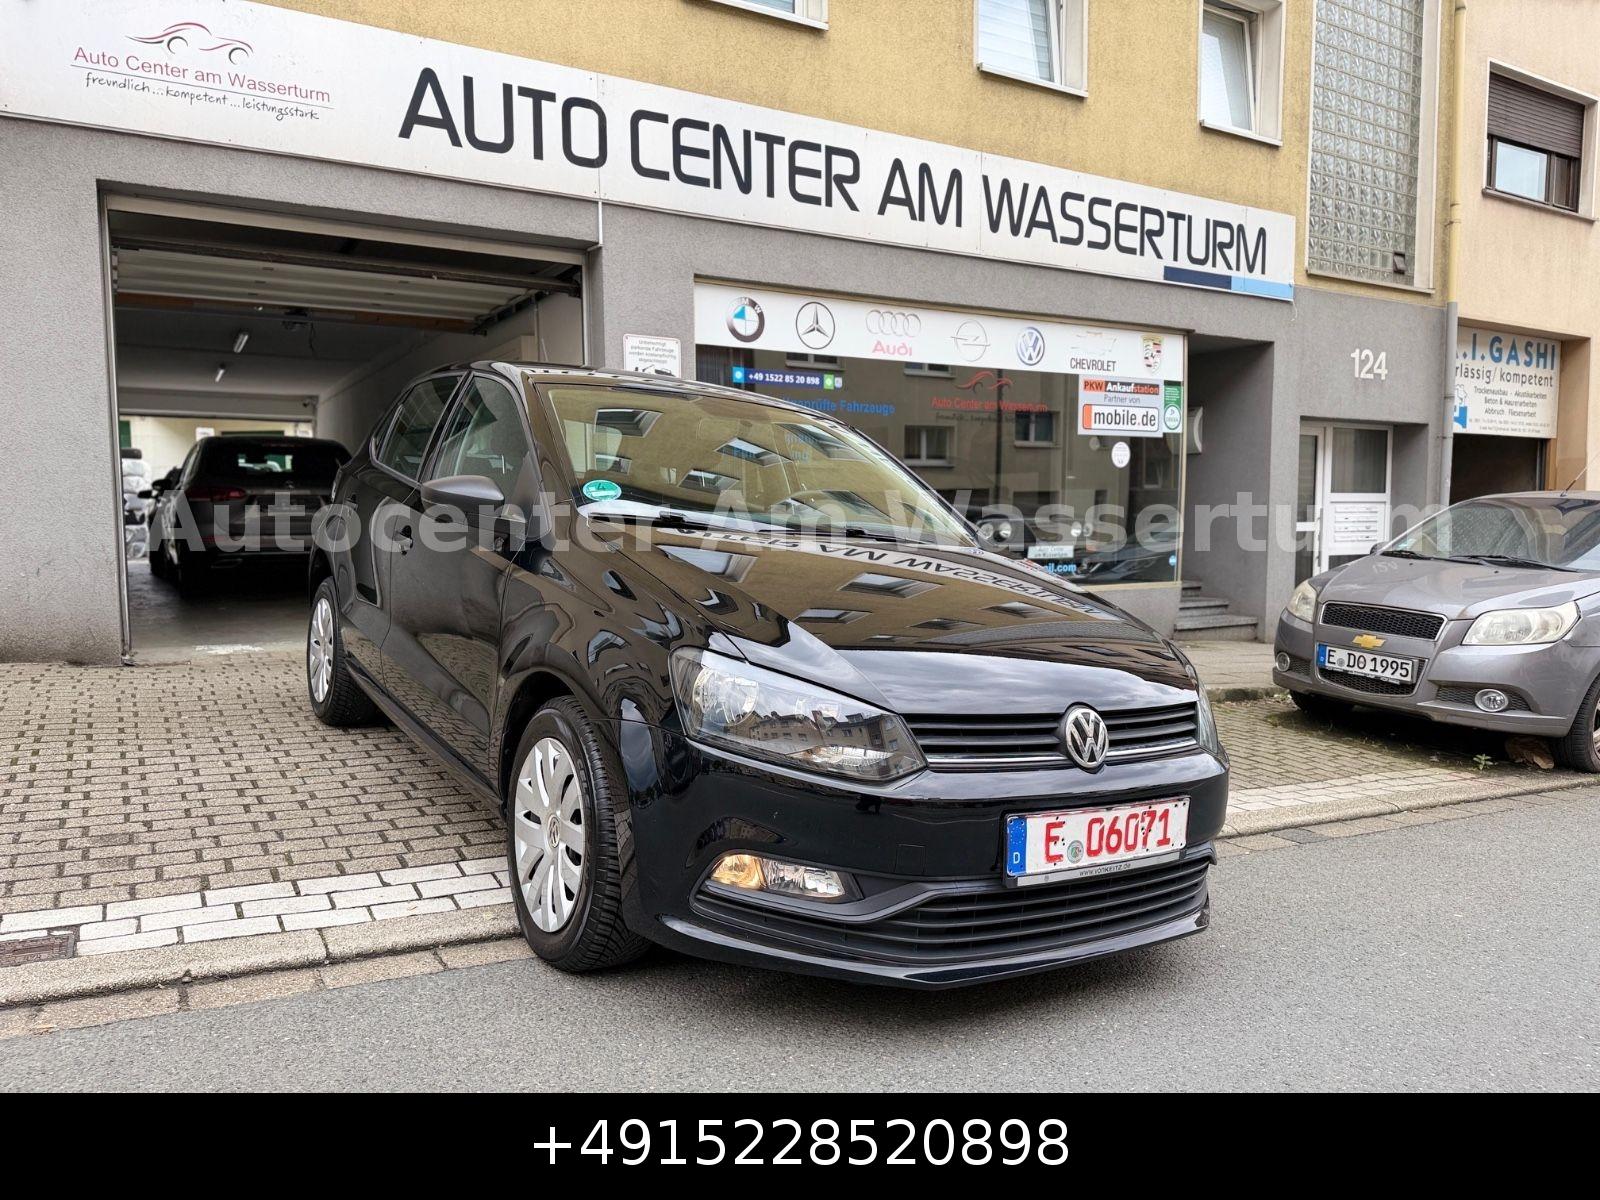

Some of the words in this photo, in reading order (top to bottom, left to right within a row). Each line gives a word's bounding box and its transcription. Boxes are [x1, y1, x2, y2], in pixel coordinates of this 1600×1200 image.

[74, 46, 119, 68] Auto
[126, 55, 189, 80] Center
[194, 66, 222, 85] am
[227, 72, 331, 103] Wasserturm
[398, 66, 608, 170] AUTO
[629, 108, 860, 212] CENTER
[877, 157, 963, 228] AM
[981, 174, 1267, 276] WASSERTURM
[871, 340, 913, 357] Audi
[1455, 333, 1556, 371] .I.GASHI
[1069, 357, 1117, 373] CHEVROLET
[1350, 348, 1388, 380] 124
[748, 373, 763, 382] +49
[765, 374, 783, 384] 1522
[785, 374, 795, 384] 85
[796, 375, 805, 385] 20
[806, 376, 820, 386] 898
[1500, 367, 1553, 388] kompetent
[1083, 379, 1104, 392] PKW
[1106, 381, 1160, 395] Ankaufstation
[1104, 394, 1127, 404] Partner
[1128, 396, 1141, 404] von
[839, 400, 896, 416] Fahrzeuge
[1094, 409, 1157, 427] mobile.de
[1043, 562, 1078, 574] il.com
[1327, 649, 1337, 665] E
[1347, 652, 1367, 670] DO
[1370, 657, 1410, 678] 1995
[1044, 820, 1066, 865] E
[1086, 807, 1171, 858] 06071
[1013, 852, 1021, 864] D
